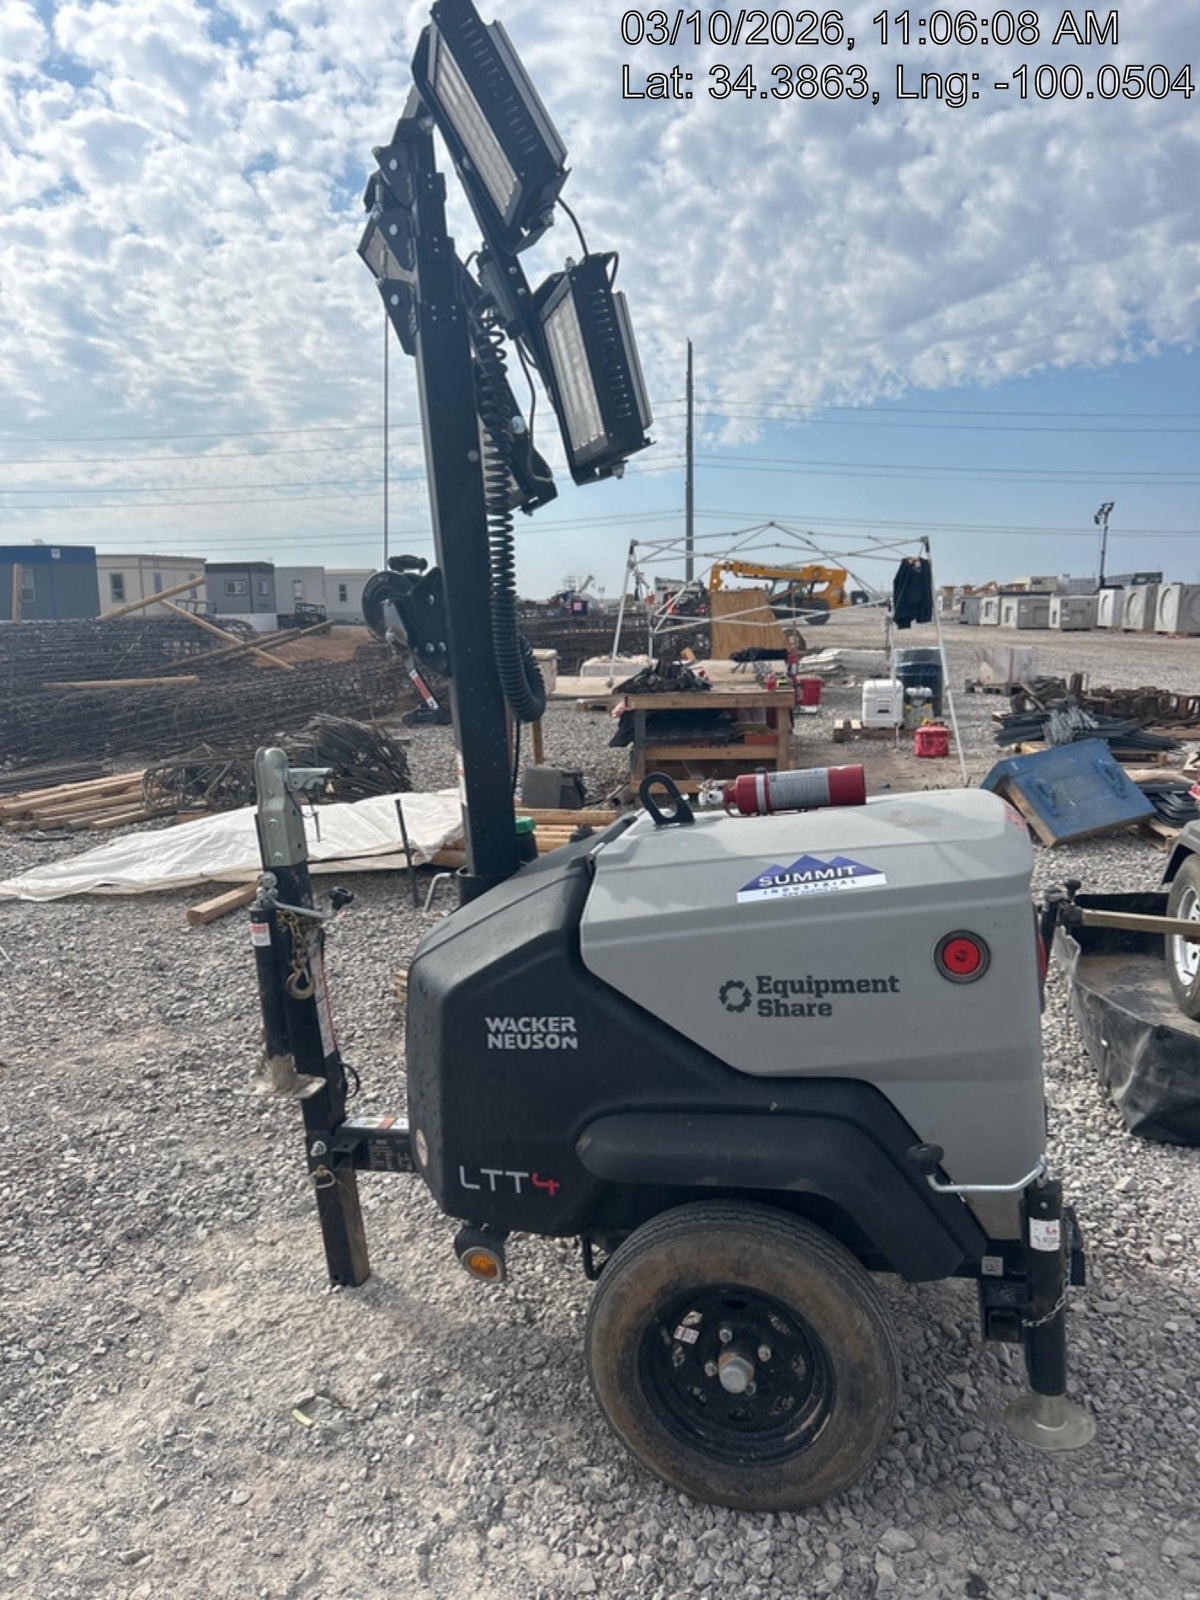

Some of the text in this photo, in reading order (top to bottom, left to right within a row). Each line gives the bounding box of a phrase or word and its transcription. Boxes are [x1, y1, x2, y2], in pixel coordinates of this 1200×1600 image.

[758, 865, 857, 888] SUMMIT
[756, 975, 901, 998] Equipment
[757, 999, 834, 1018] Share
[485, 1016, 578, 1032] WACKER
[487, 1033, 578, 1050] NEUSON
[459, 1165, 560, 1196] LTT4
